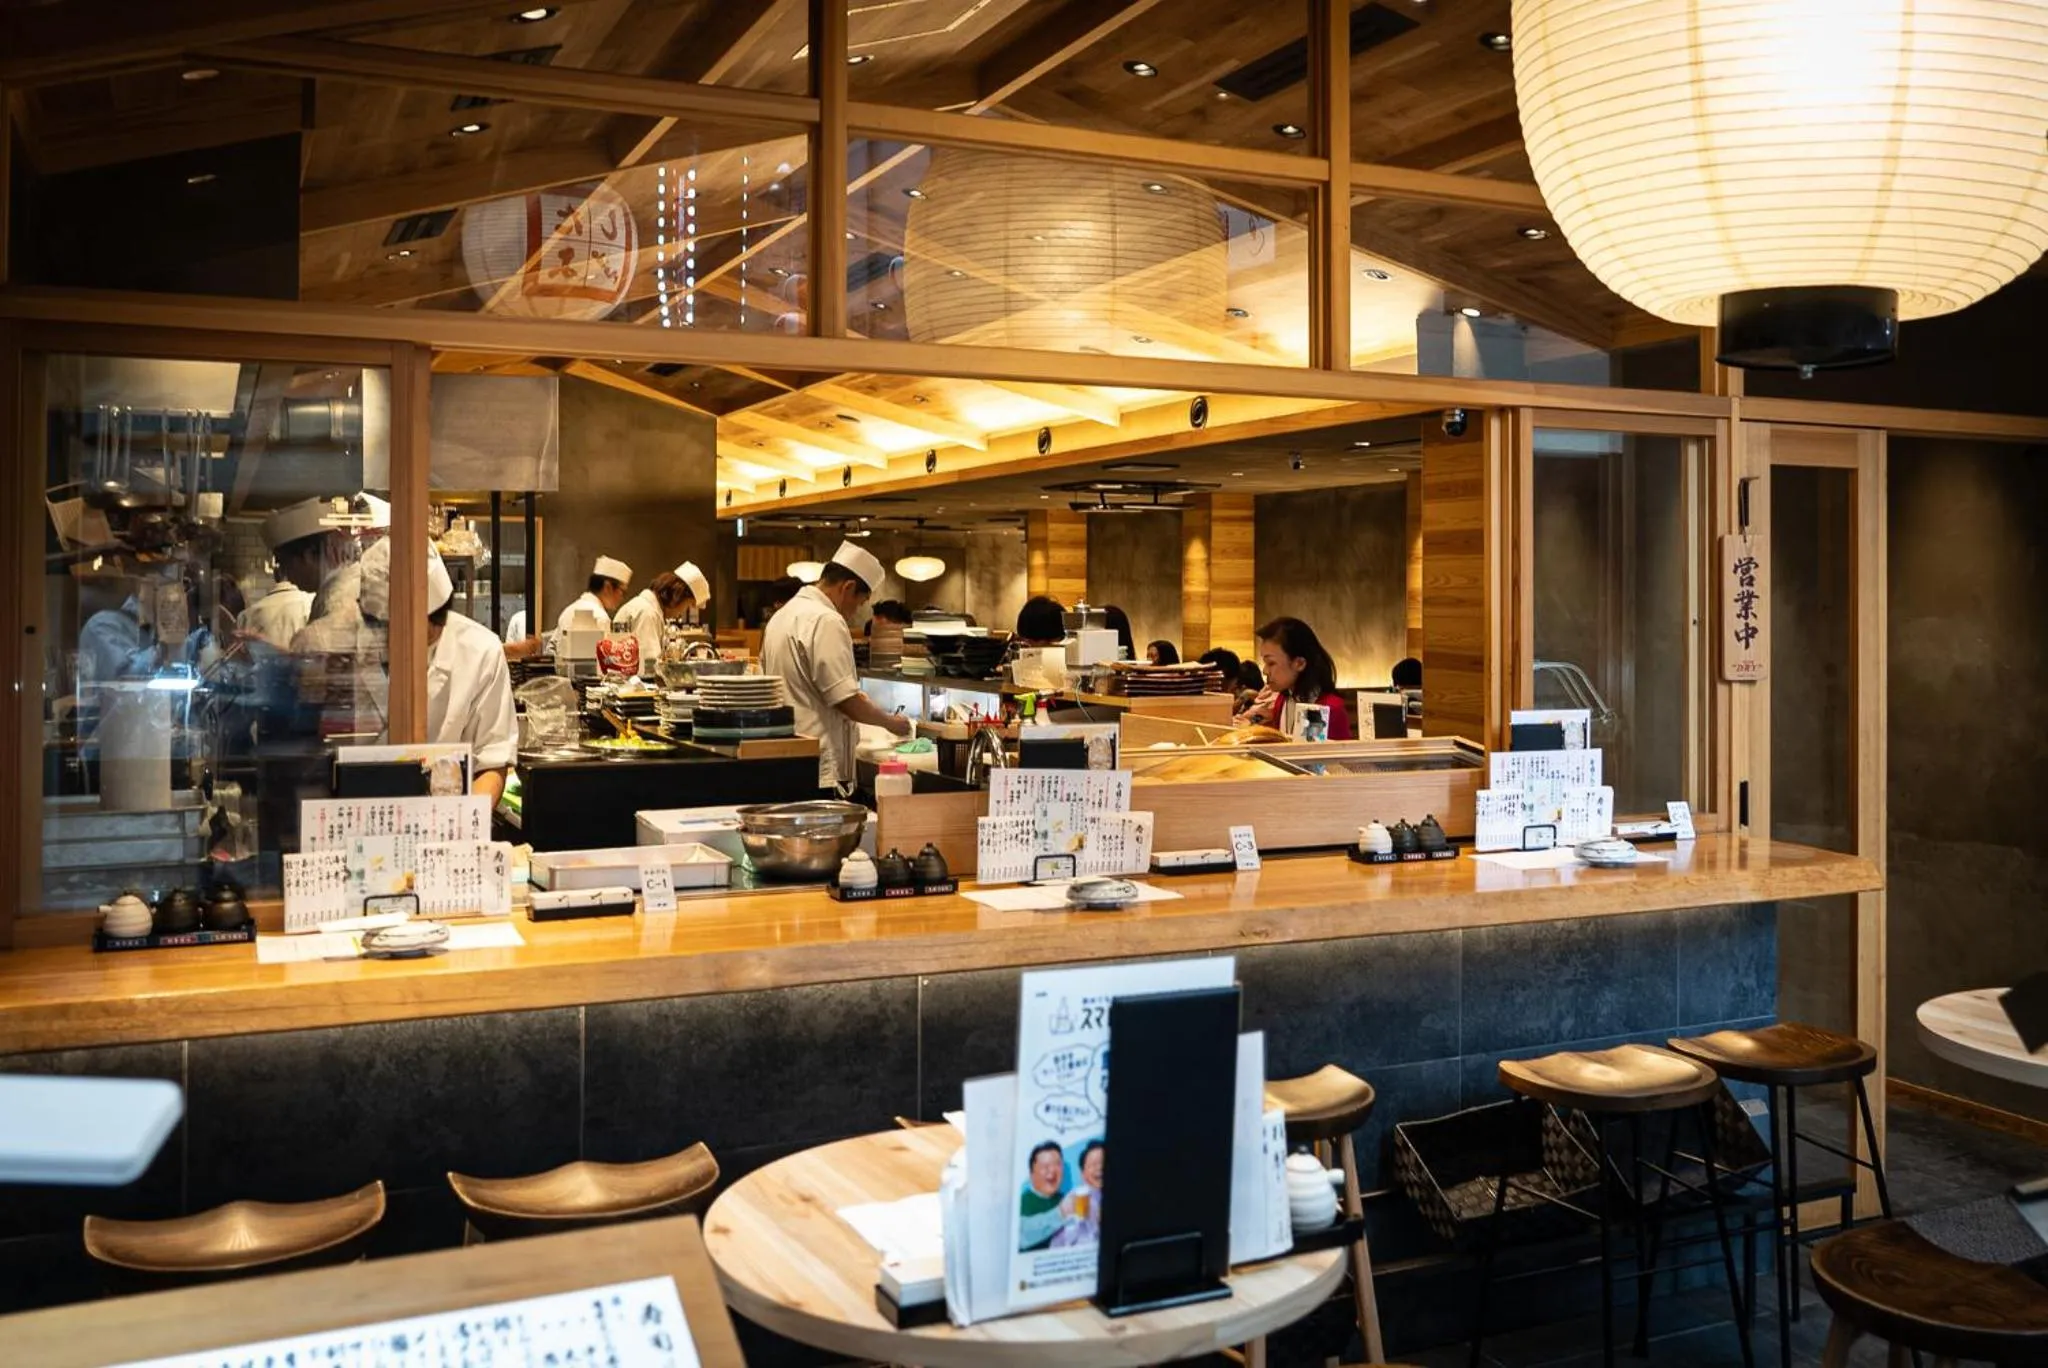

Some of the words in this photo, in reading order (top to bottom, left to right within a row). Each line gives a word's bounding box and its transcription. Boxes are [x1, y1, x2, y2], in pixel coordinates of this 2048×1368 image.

[1732, 556, 1760, 651] 営業中
[646, 877, 668, 889] C-1
[1080, 1006, 1111, 1030] スマ
